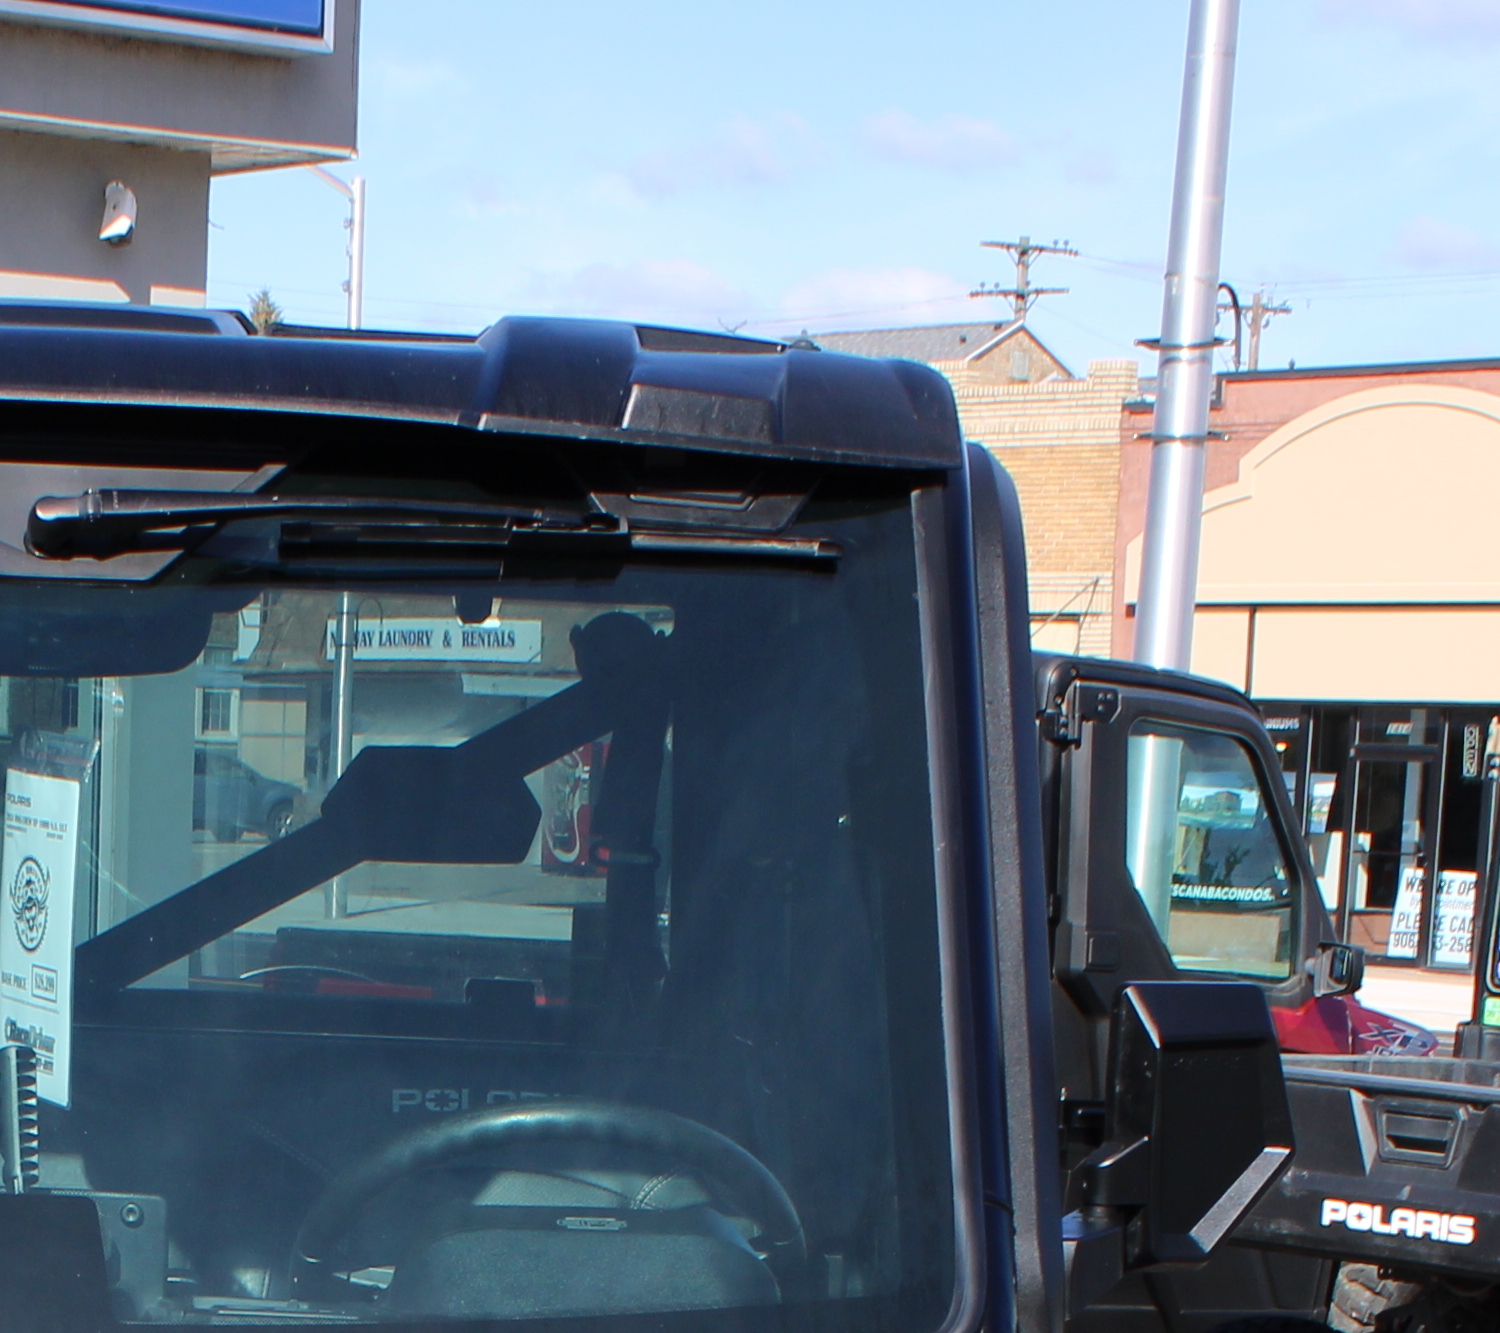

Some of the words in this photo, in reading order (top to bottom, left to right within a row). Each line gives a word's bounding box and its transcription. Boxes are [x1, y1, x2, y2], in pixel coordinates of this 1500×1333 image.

[379, 630, 433, 647] LAUNDRY
[442, 631, 451, 647] &
[462, 631, 515, 647] RENTALS
[1320, 1198, 1479, 1245] POLARIS
